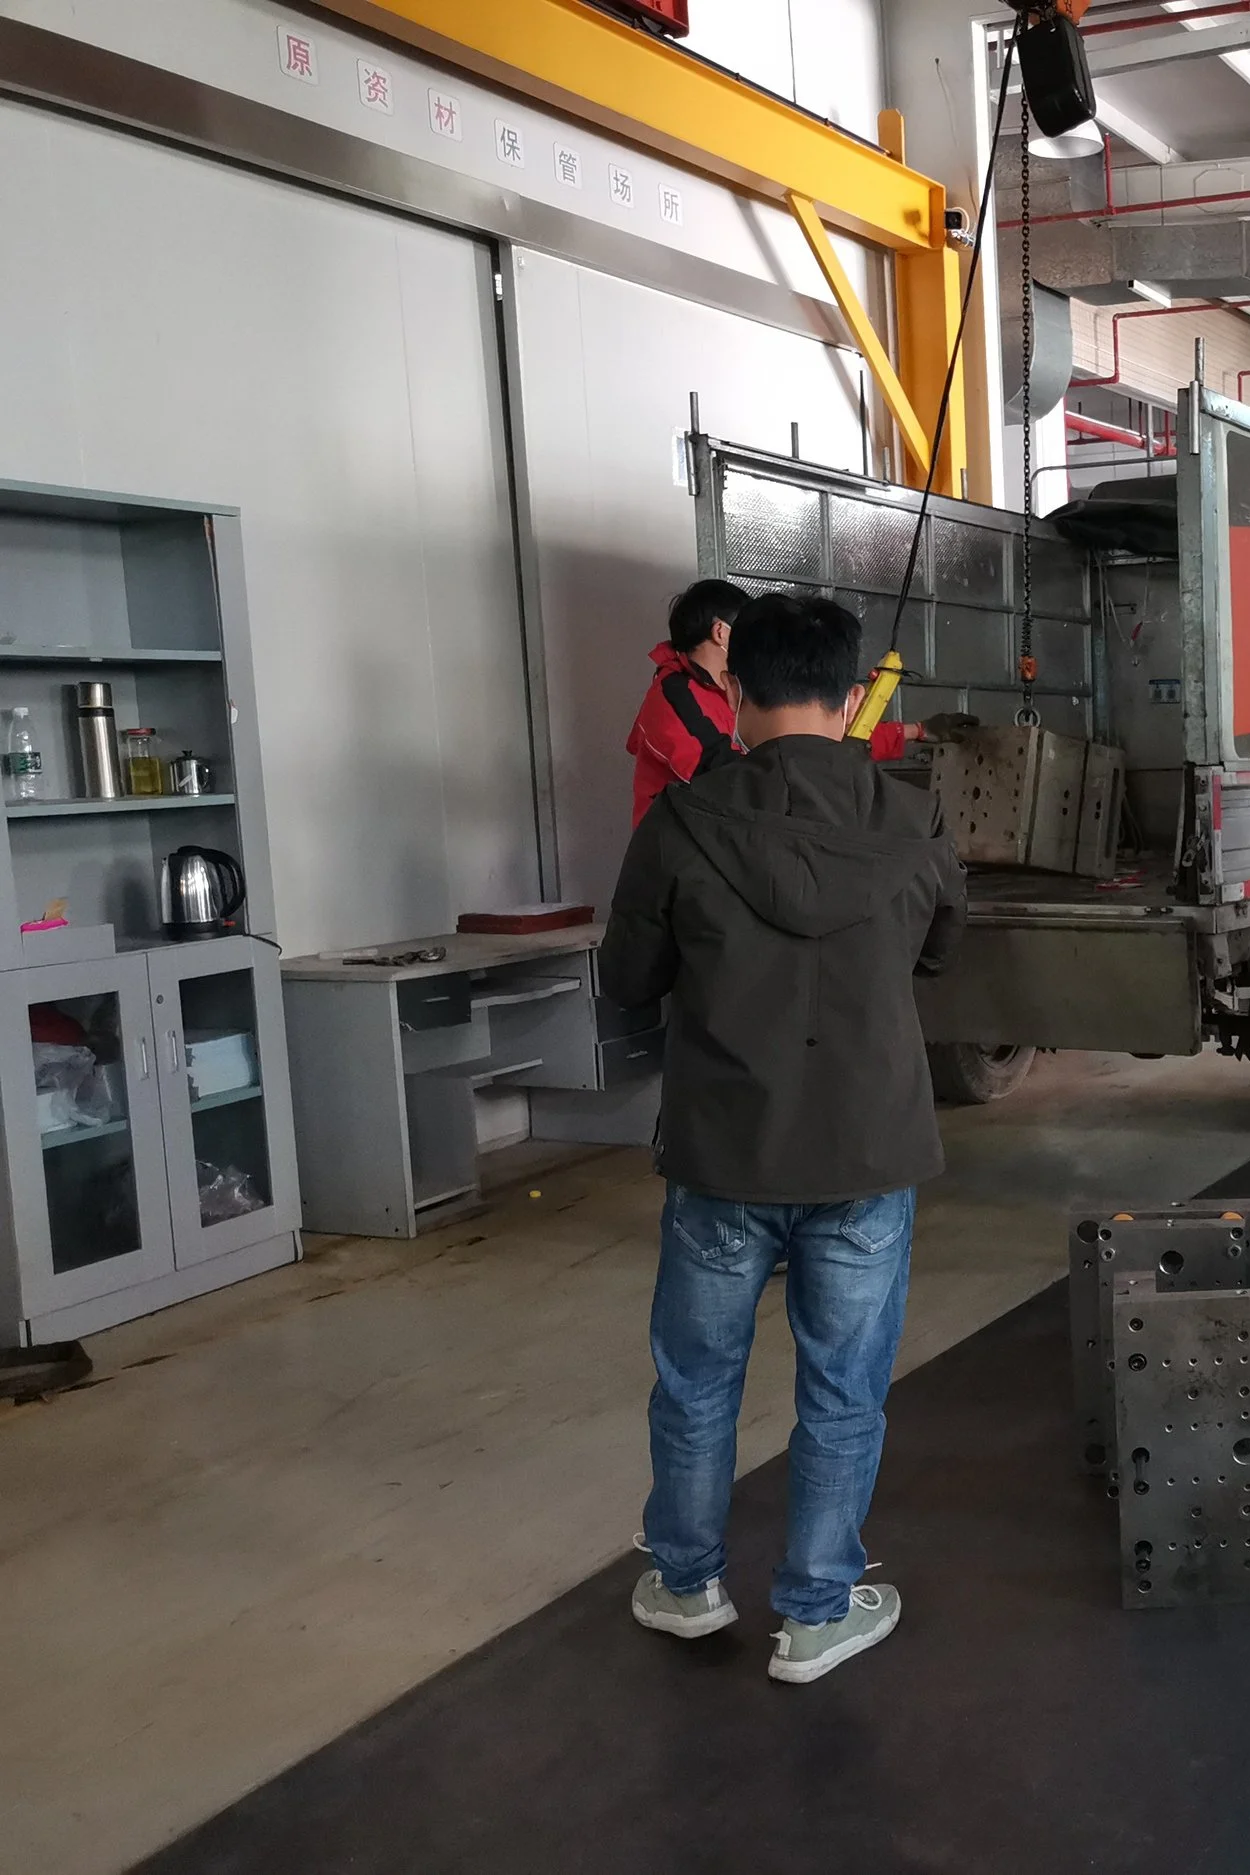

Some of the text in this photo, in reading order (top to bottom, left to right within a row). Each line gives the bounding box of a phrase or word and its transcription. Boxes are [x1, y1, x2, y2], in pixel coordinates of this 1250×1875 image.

[284, 34, 681, 221] 原资材保管场所
